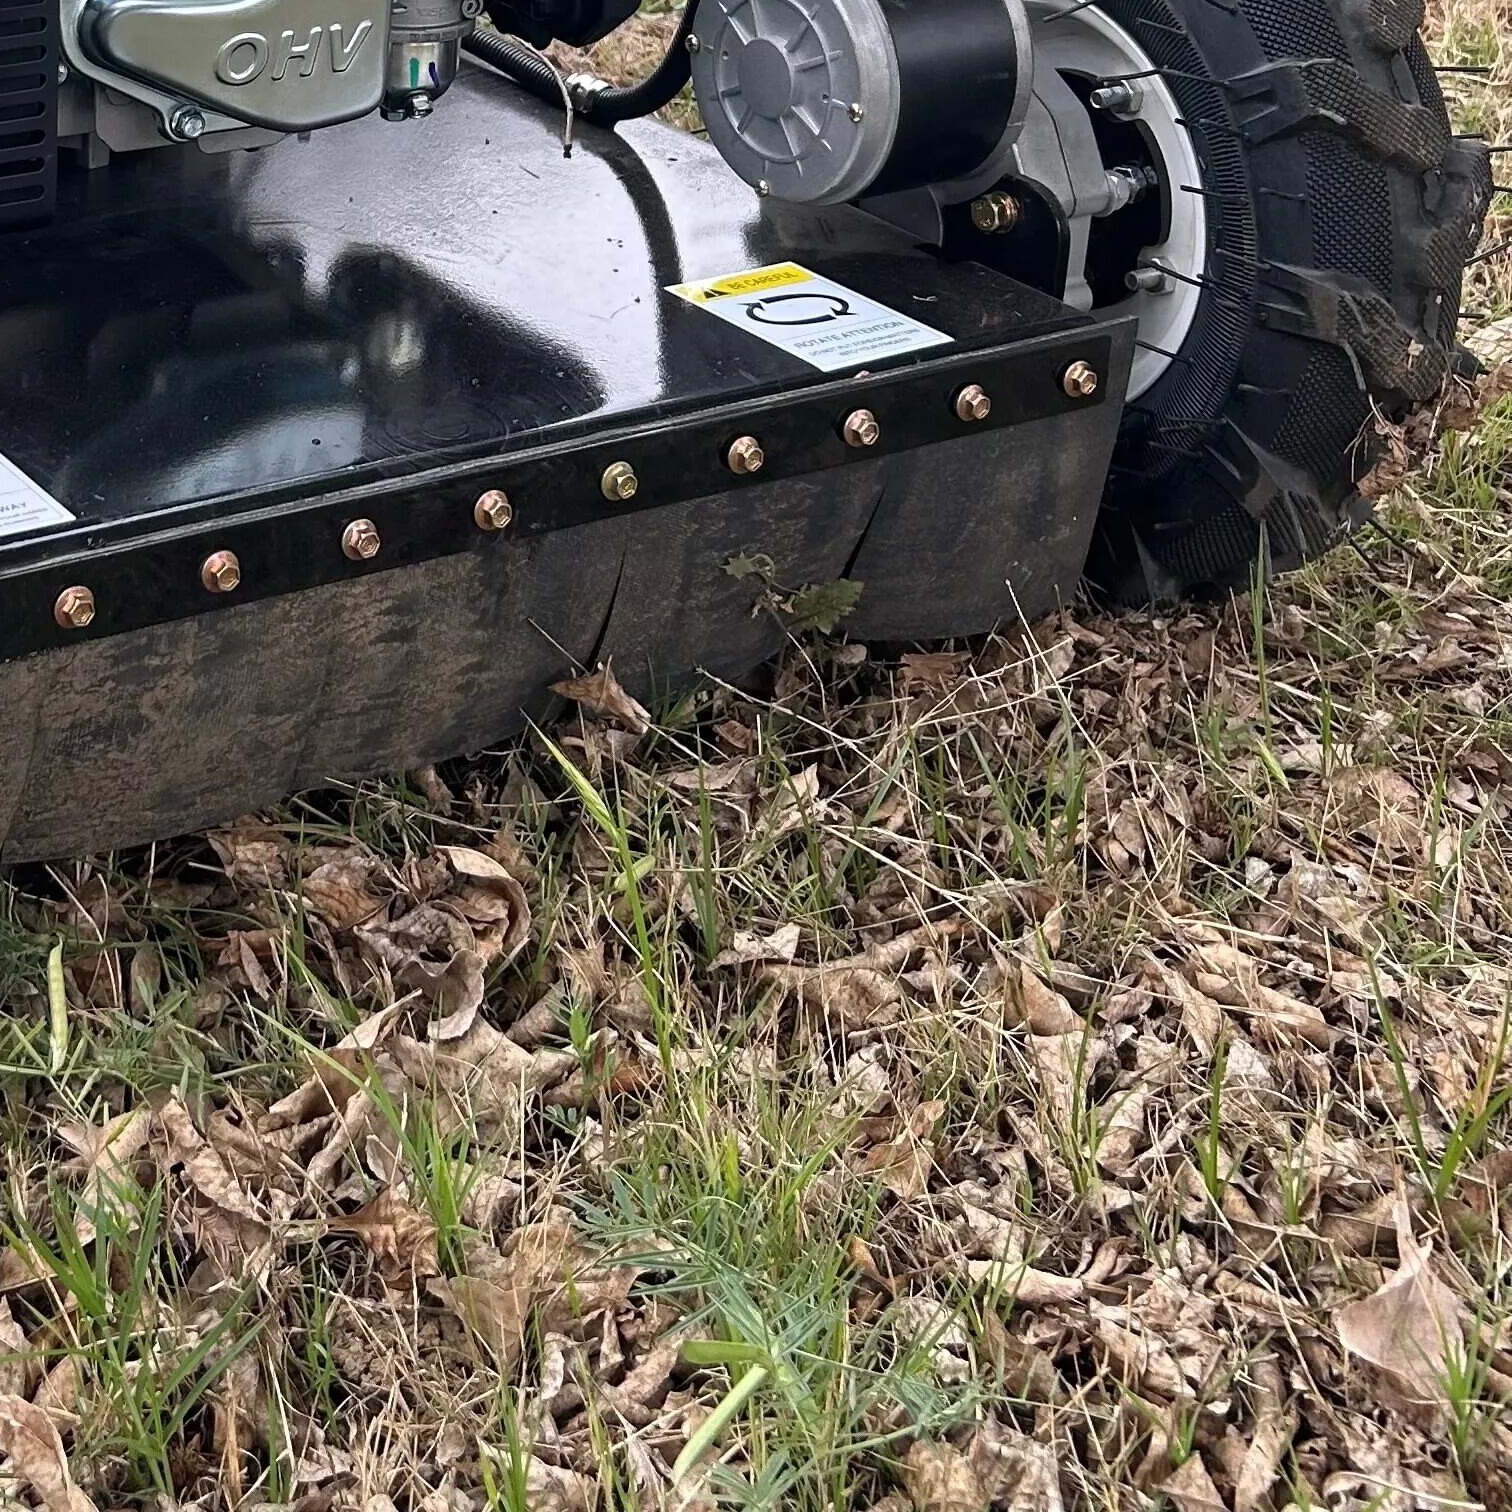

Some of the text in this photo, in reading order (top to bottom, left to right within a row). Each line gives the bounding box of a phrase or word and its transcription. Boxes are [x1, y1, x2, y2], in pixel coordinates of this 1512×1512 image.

[214, 19, 373, 86] OHV
[744, 271, 798, 287] CAREFUL
[793, 334, 841, 349] ROTATE
[840, 321, 905, 338] ATTENTION
